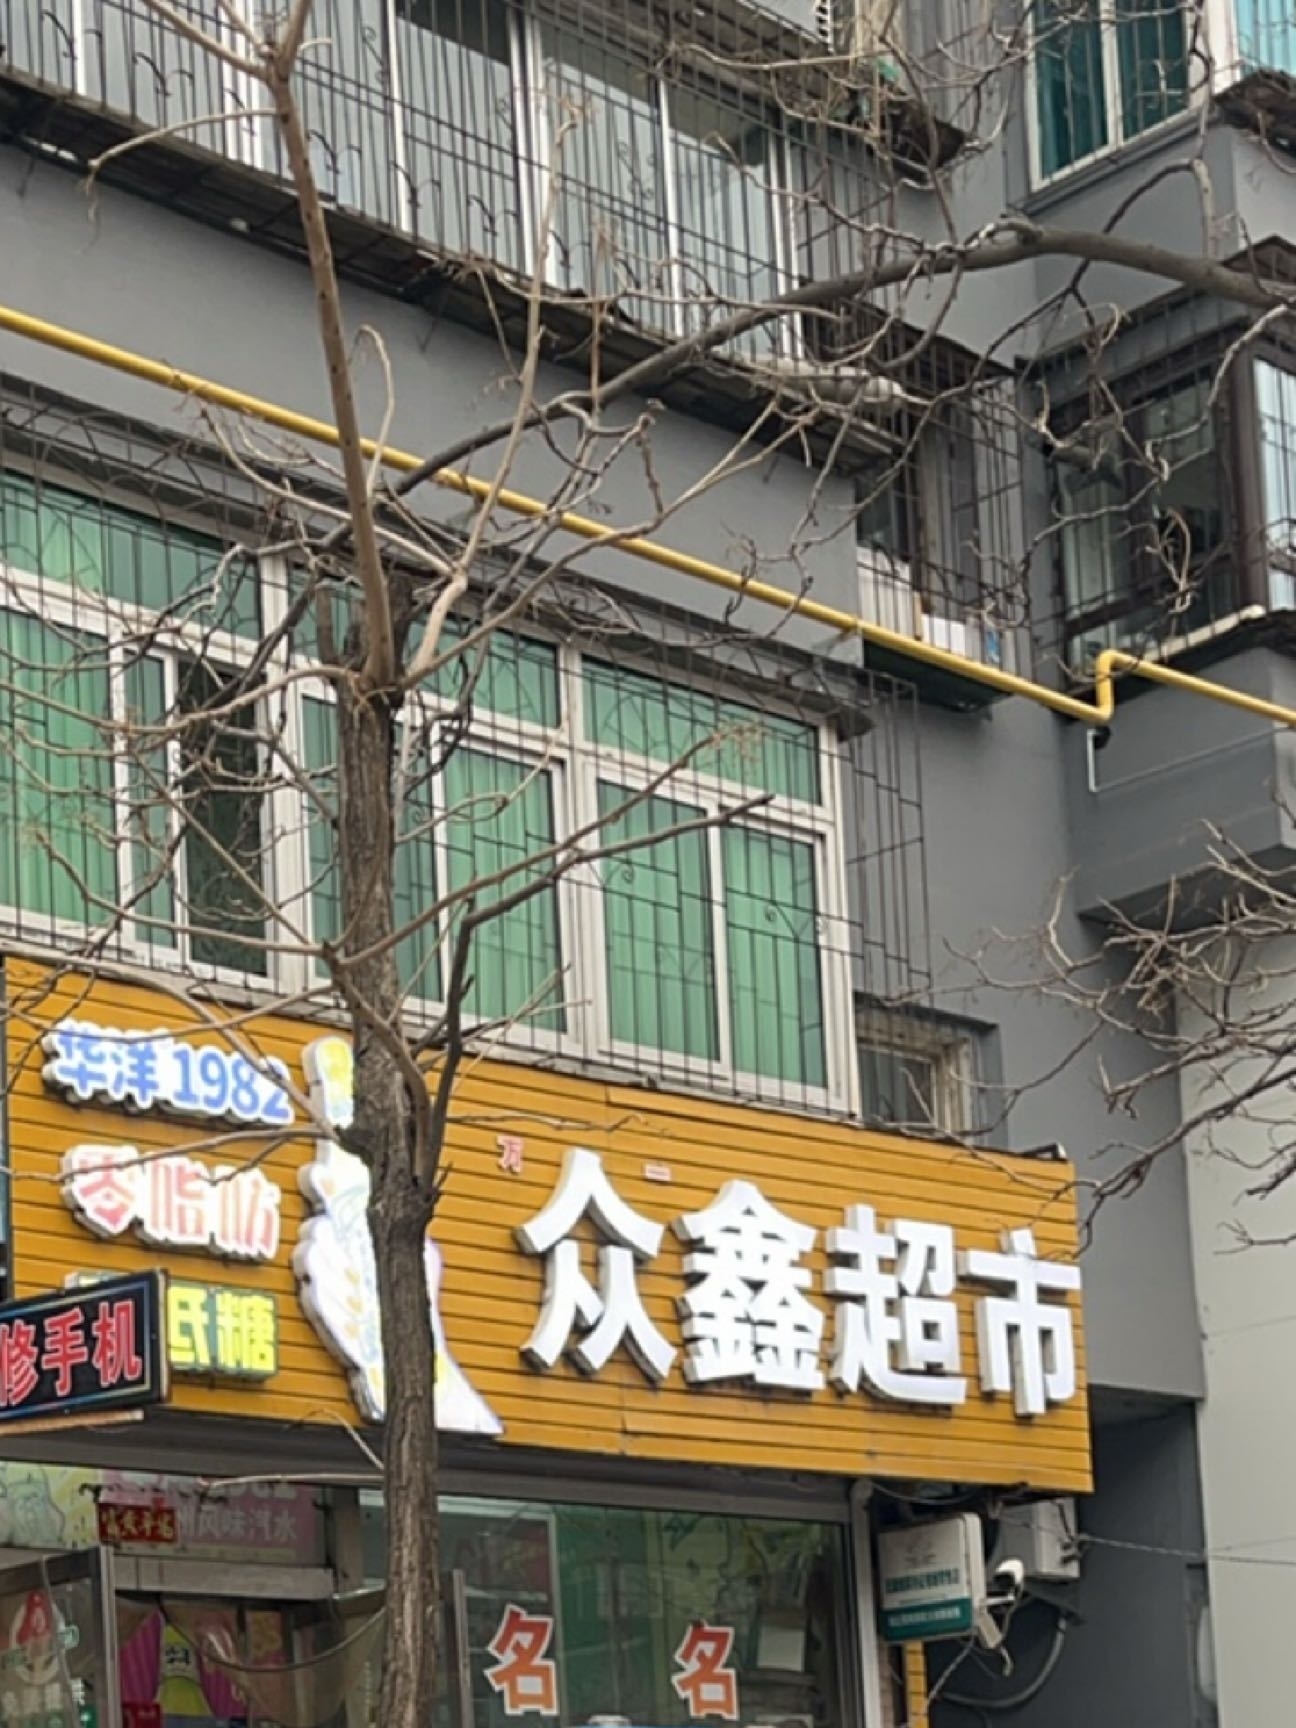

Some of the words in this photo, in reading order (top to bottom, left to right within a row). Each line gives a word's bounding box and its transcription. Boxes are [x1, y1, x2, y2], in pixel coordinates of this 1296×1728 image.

[516, 1146, 1082, 1417] 众鑫超市
[483, 1604, 560, 1717] 名
[671, 1618, 739, 1721] 名
